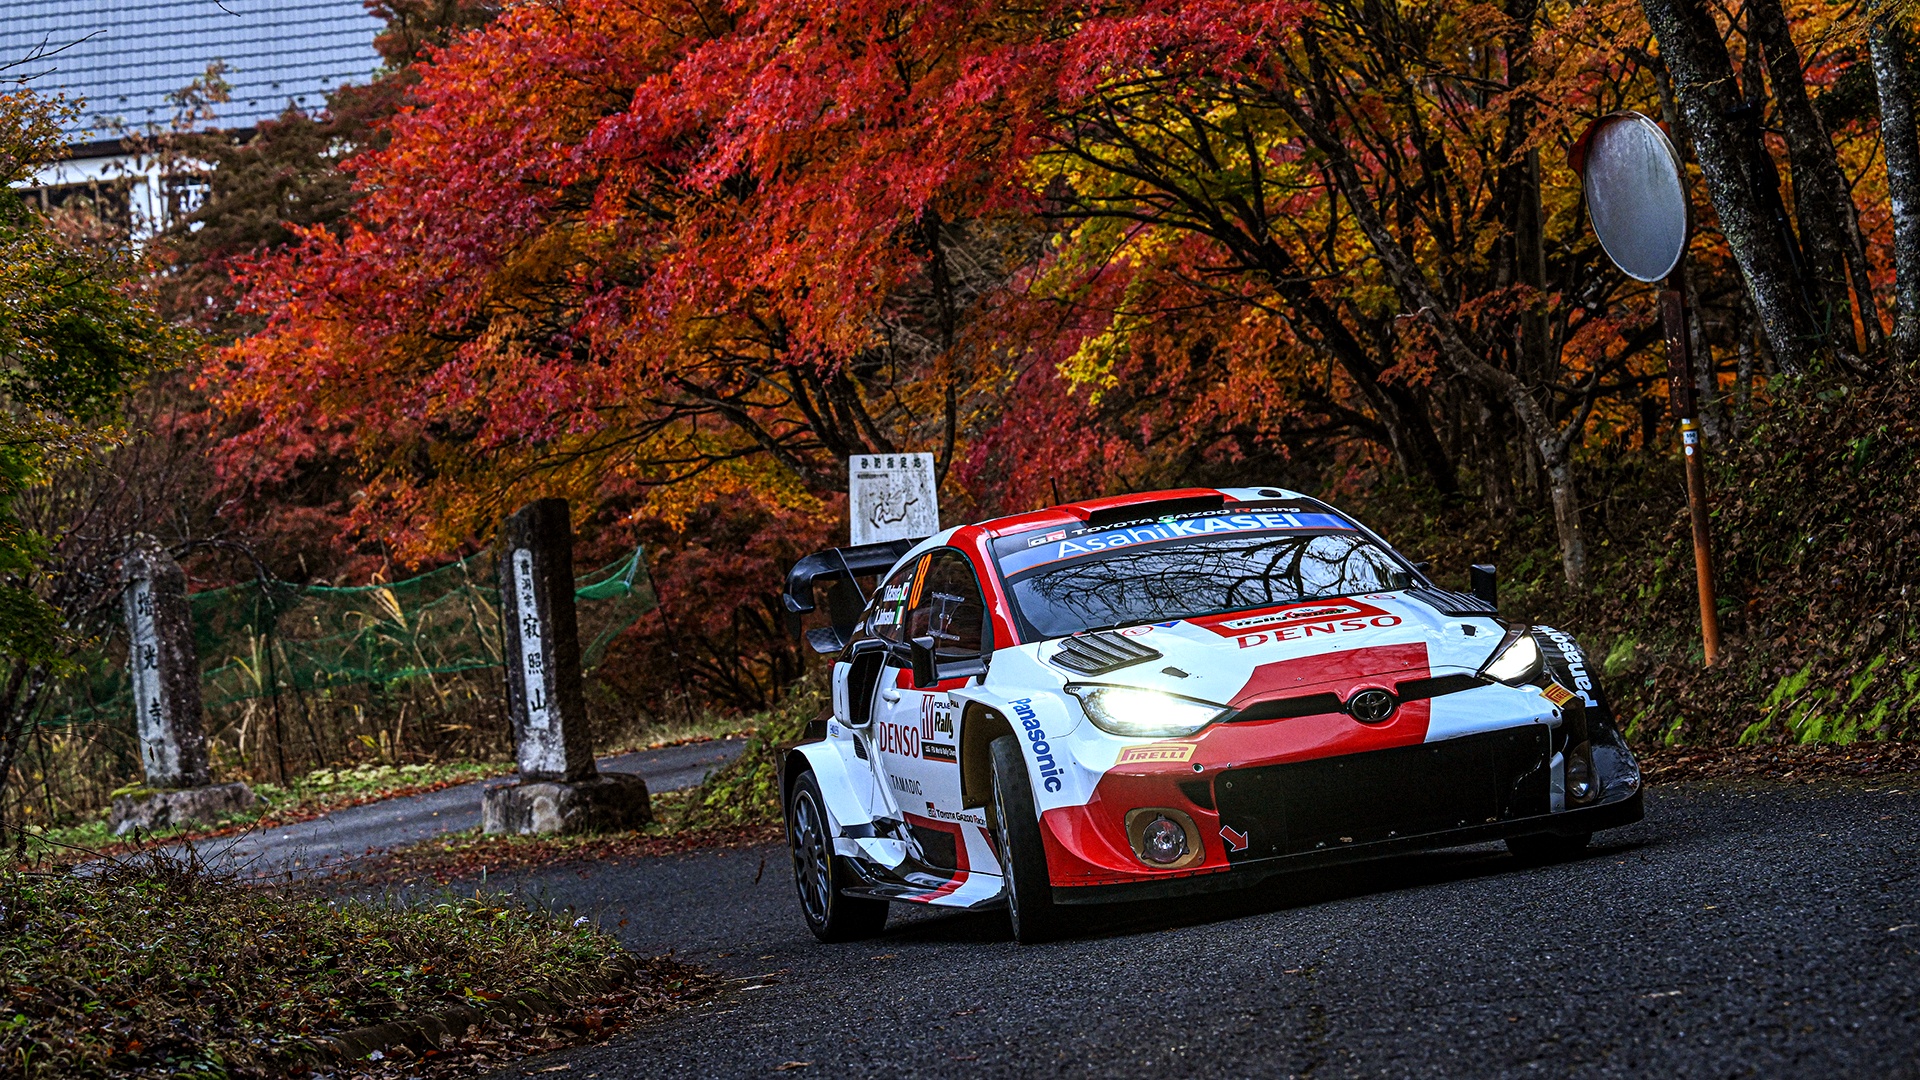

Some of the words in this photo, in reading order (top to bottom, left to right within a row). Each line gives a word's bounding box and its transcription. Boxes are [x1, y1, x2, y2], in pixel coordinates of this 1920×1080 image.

[1071, 517, 1154, 535] TOYOTA
[1158, 509, 1231, 524] GAZOO
[907, 553, 932, 611] 18
[1236, 615, 1402, 650] DENSO
[934, 711, 954, 739] Rally
[880, 722, 920, 758] DENSO
[1008, 697, 1065, 793] Panasonic
[1121, 747, 1188, 761] PIRELLI
[890, 775, 923, 796] TAMADIC
[936, 809, 956, 819] TOYOTA
